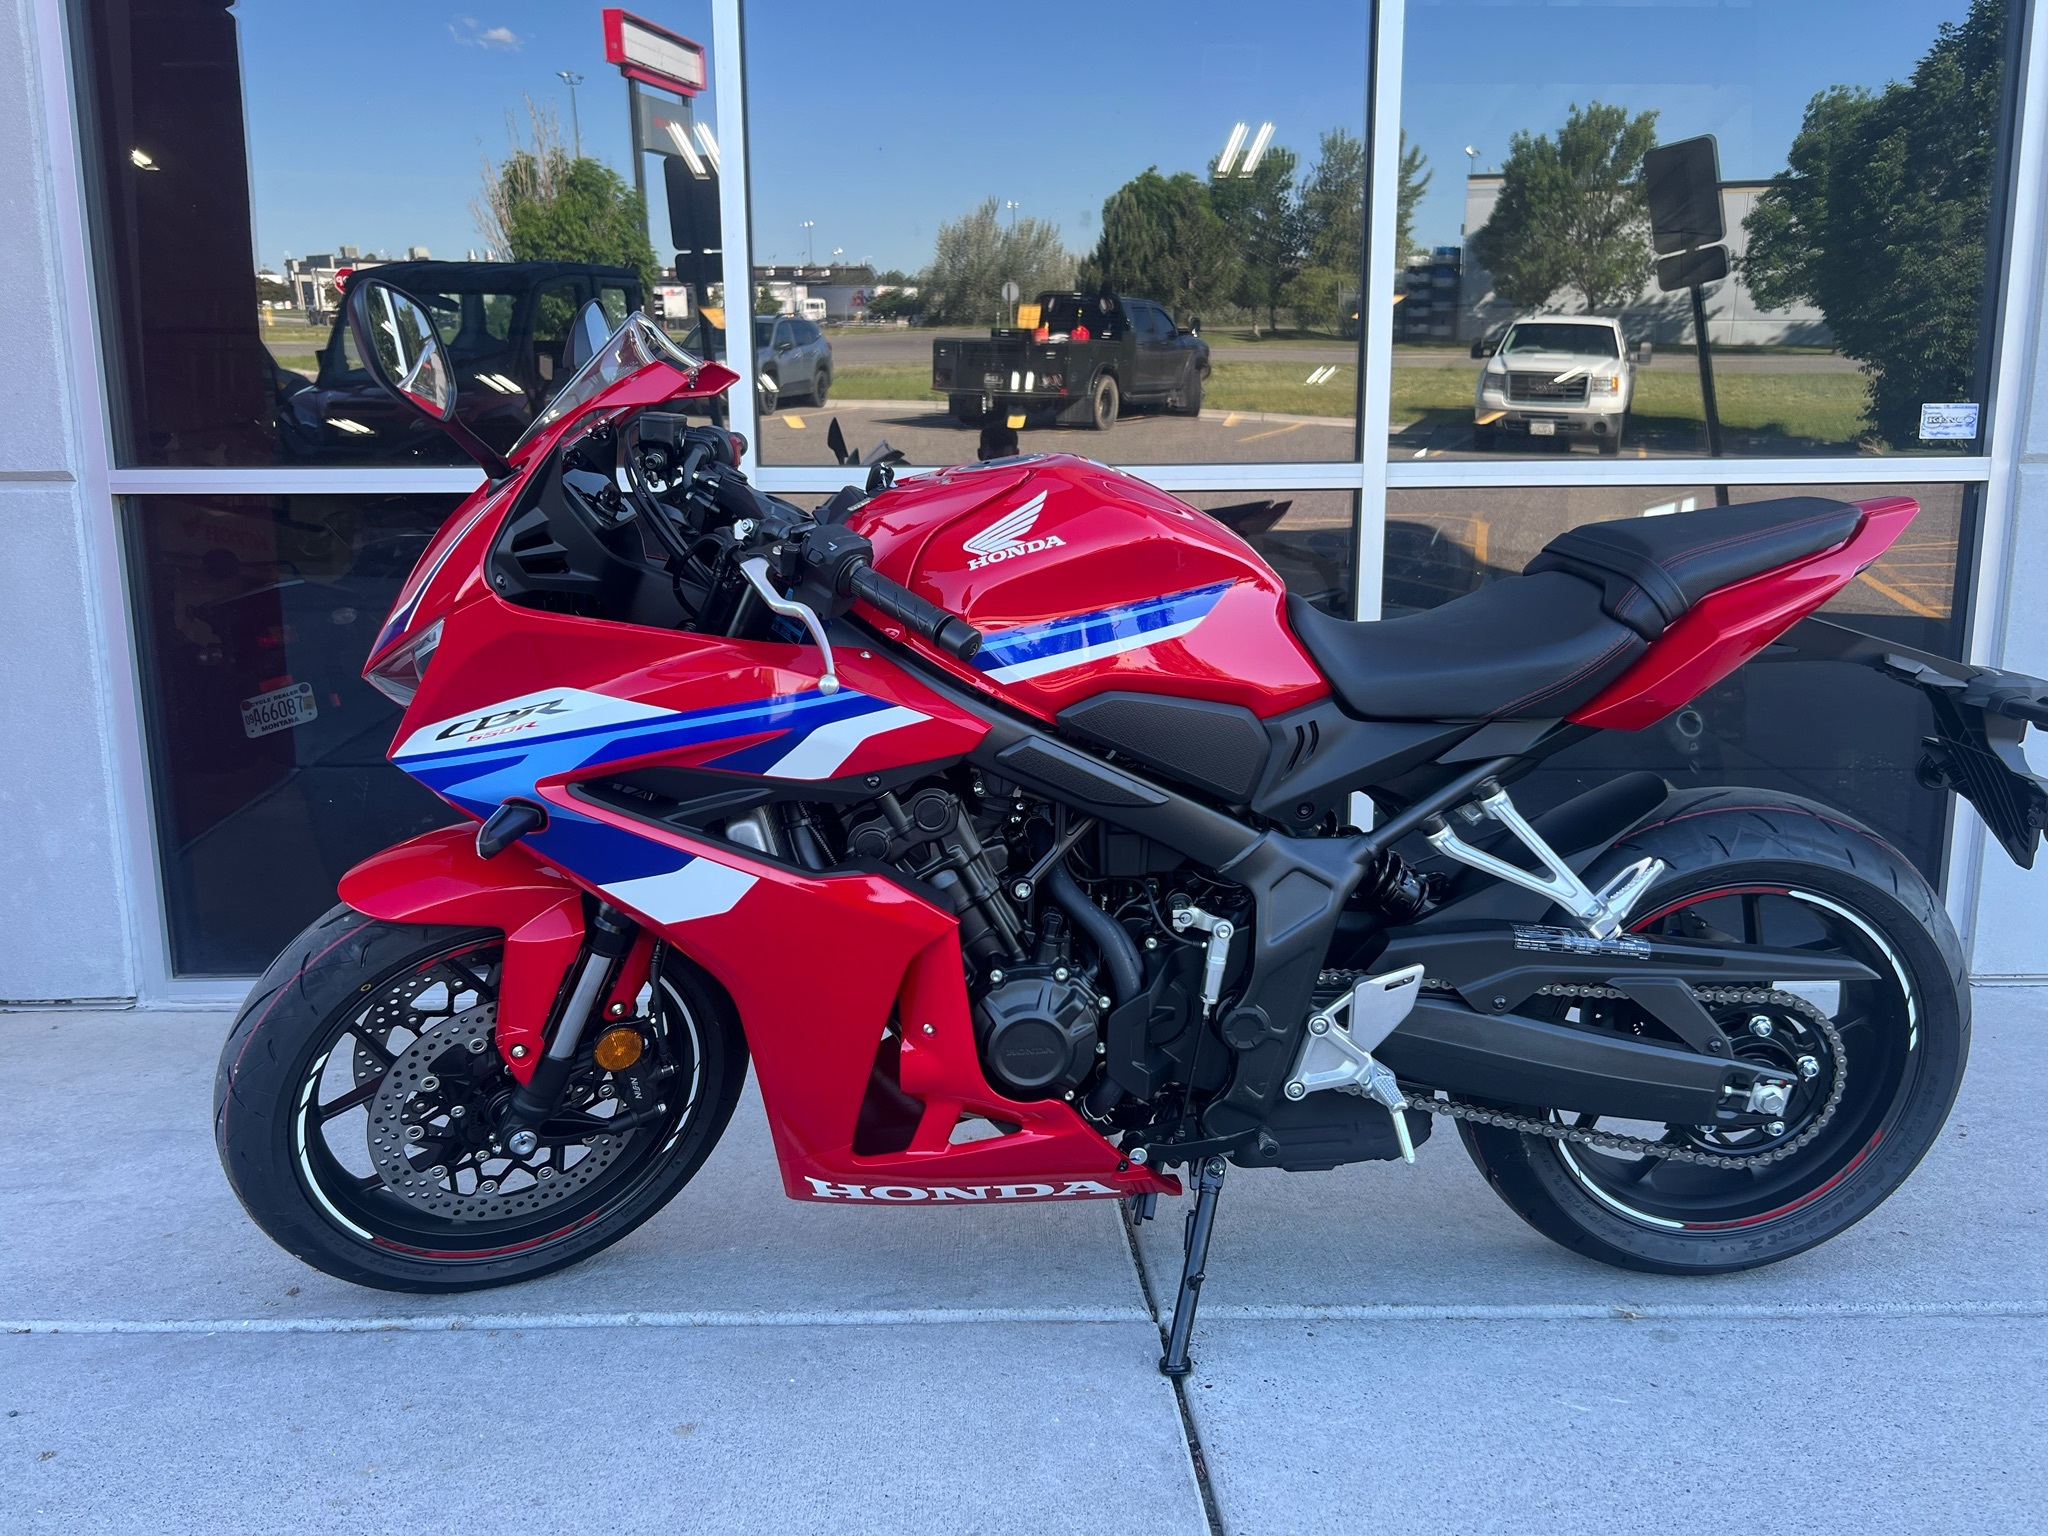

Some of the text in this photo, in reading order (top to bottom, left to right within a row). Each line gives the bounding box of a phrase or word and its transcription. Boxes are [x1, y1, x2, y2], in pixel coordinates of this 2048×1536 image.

[967, 535, 1067, 572] HONDA
[273, 689, 299, 701] DEALER
[254, 695, 303, 727] A66087
[435, 698, 573, 741] CBR
[261, 716, 300, 732] MONTANA
[466, 720, 539, 743] 650R
[1006, 1047, 1055, 1057] HONDA
[804, 1175, 1121, 1200] HONDA
